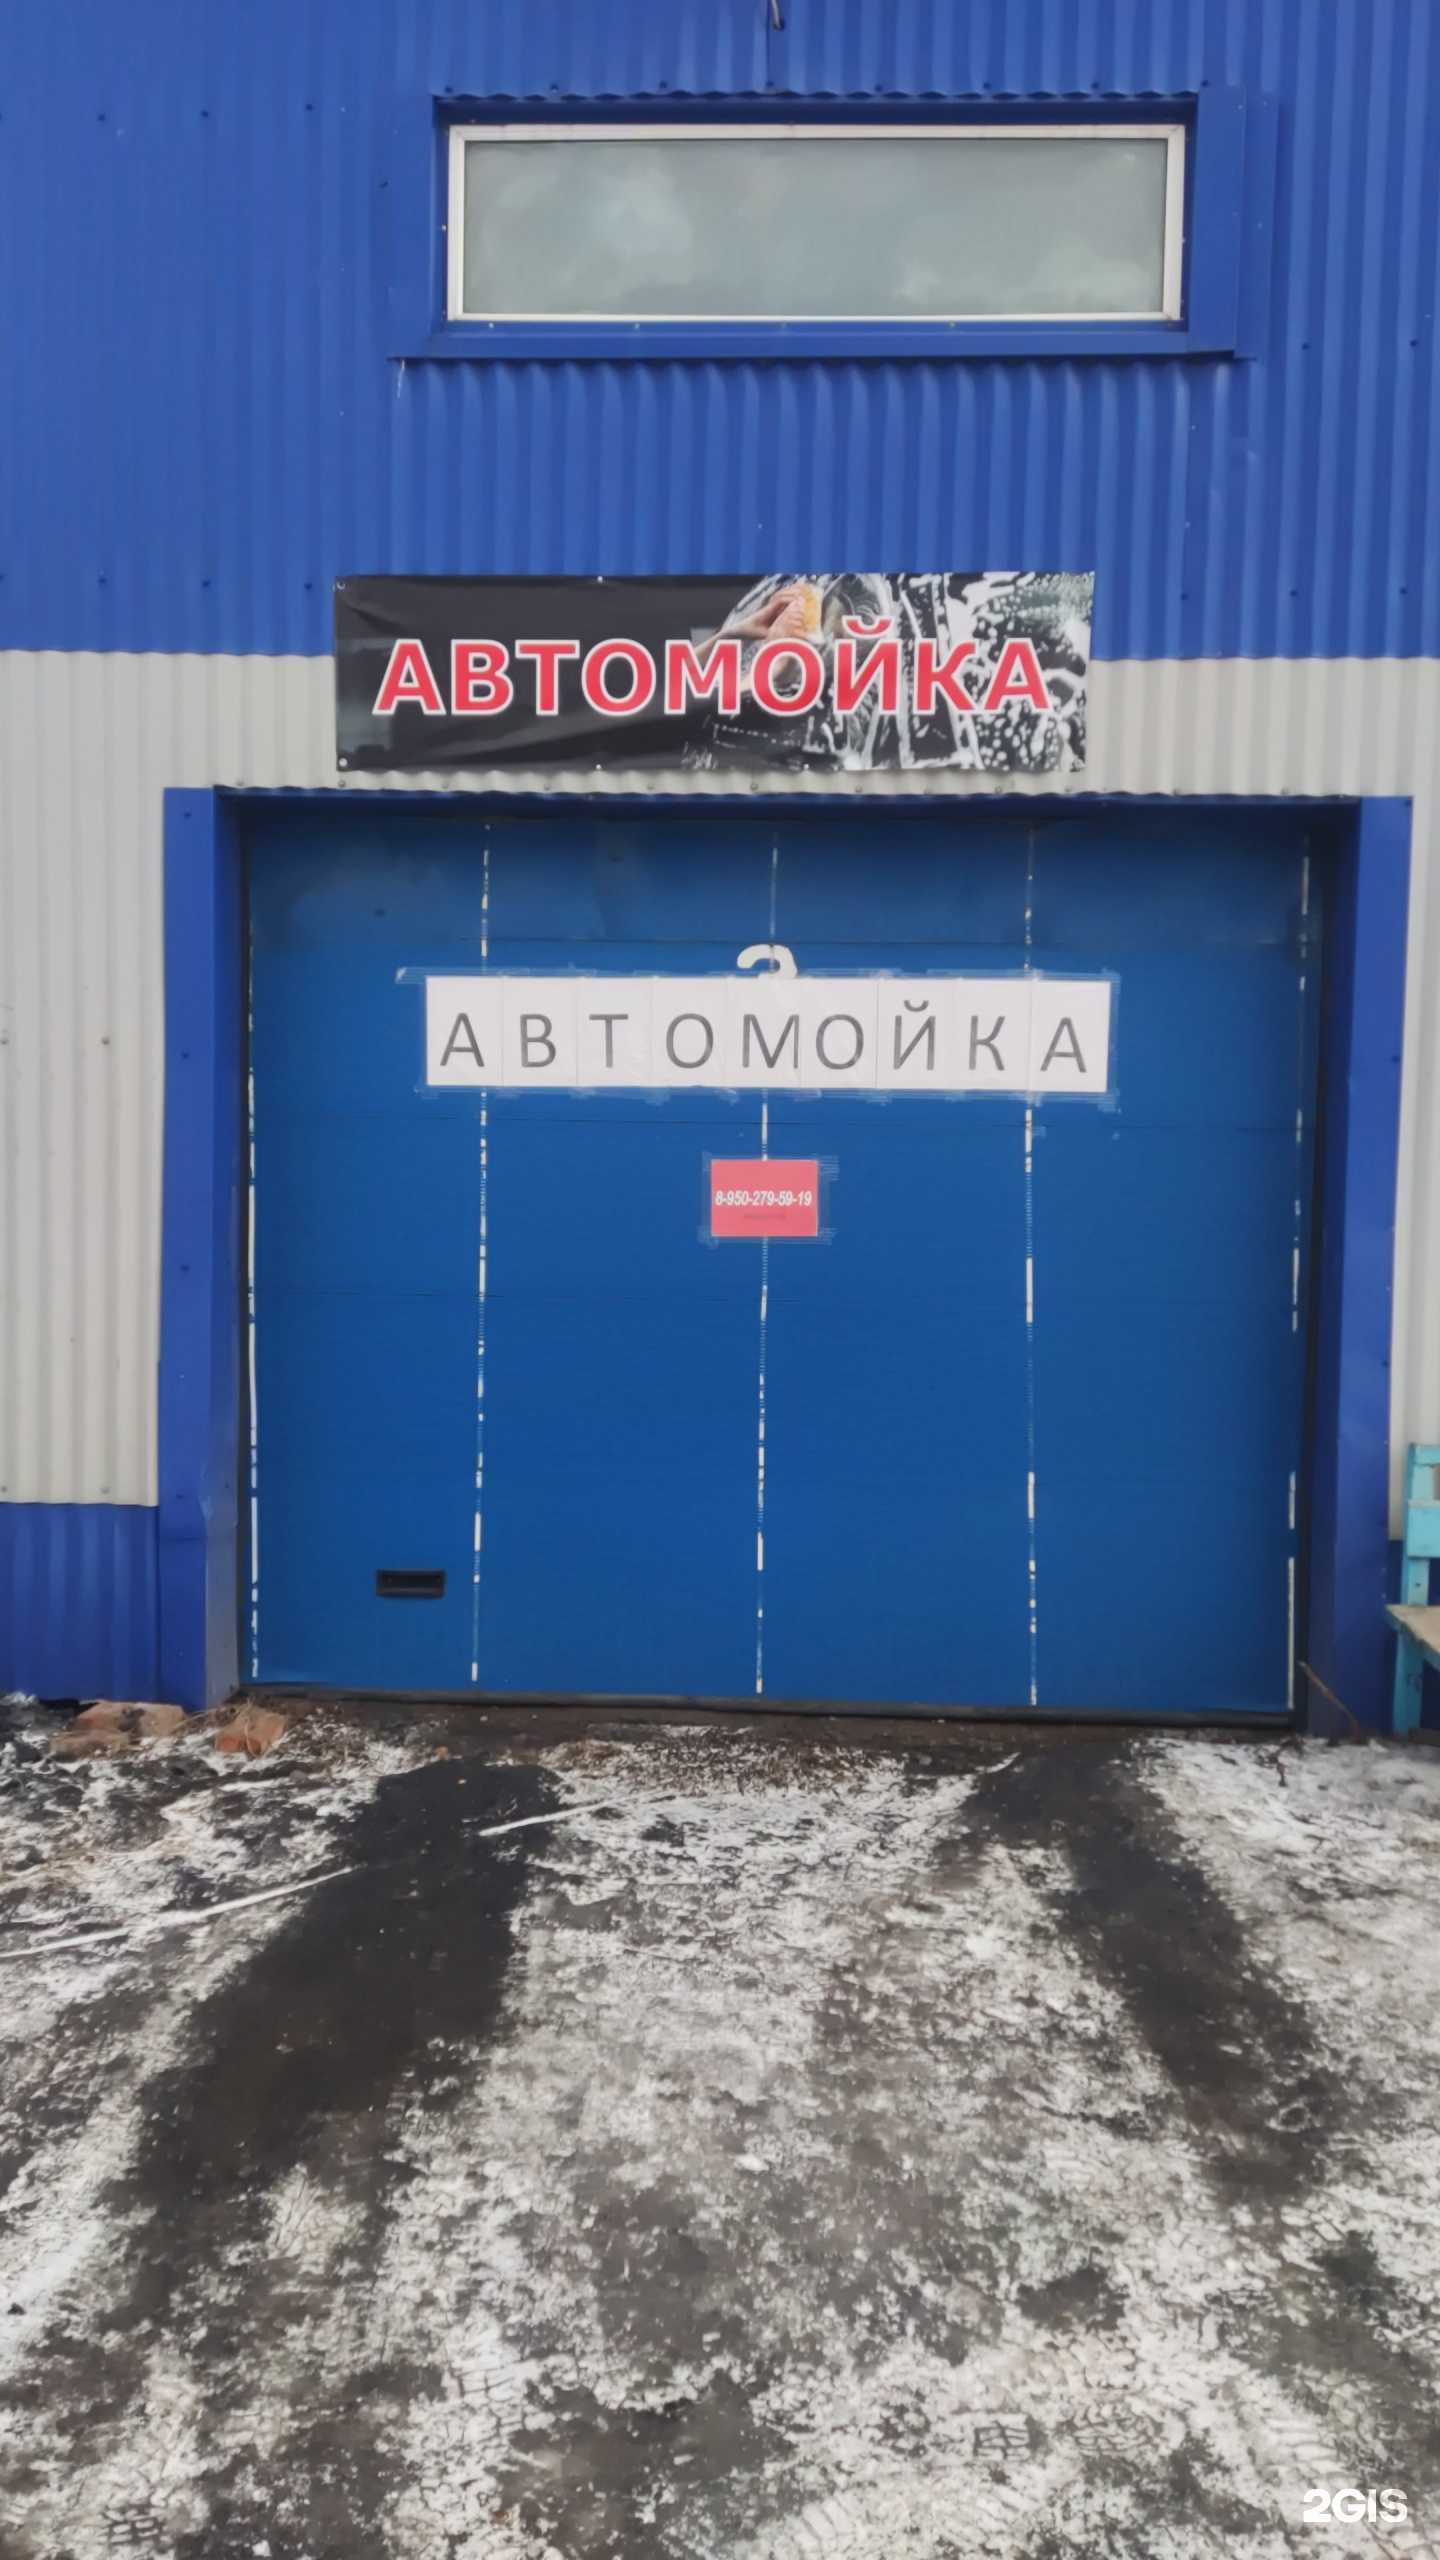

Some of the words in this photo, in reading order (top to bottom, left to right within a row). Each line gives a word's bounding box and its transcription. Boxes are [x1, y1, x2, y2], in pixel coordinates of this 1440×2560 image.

[372, 615, 1052, 717] АВТОМОЙКА
[439, 1000, 1088, 1074] АВТОМОЙКА
[715, 1189, 812, 1206] 8-950-279-59-19
